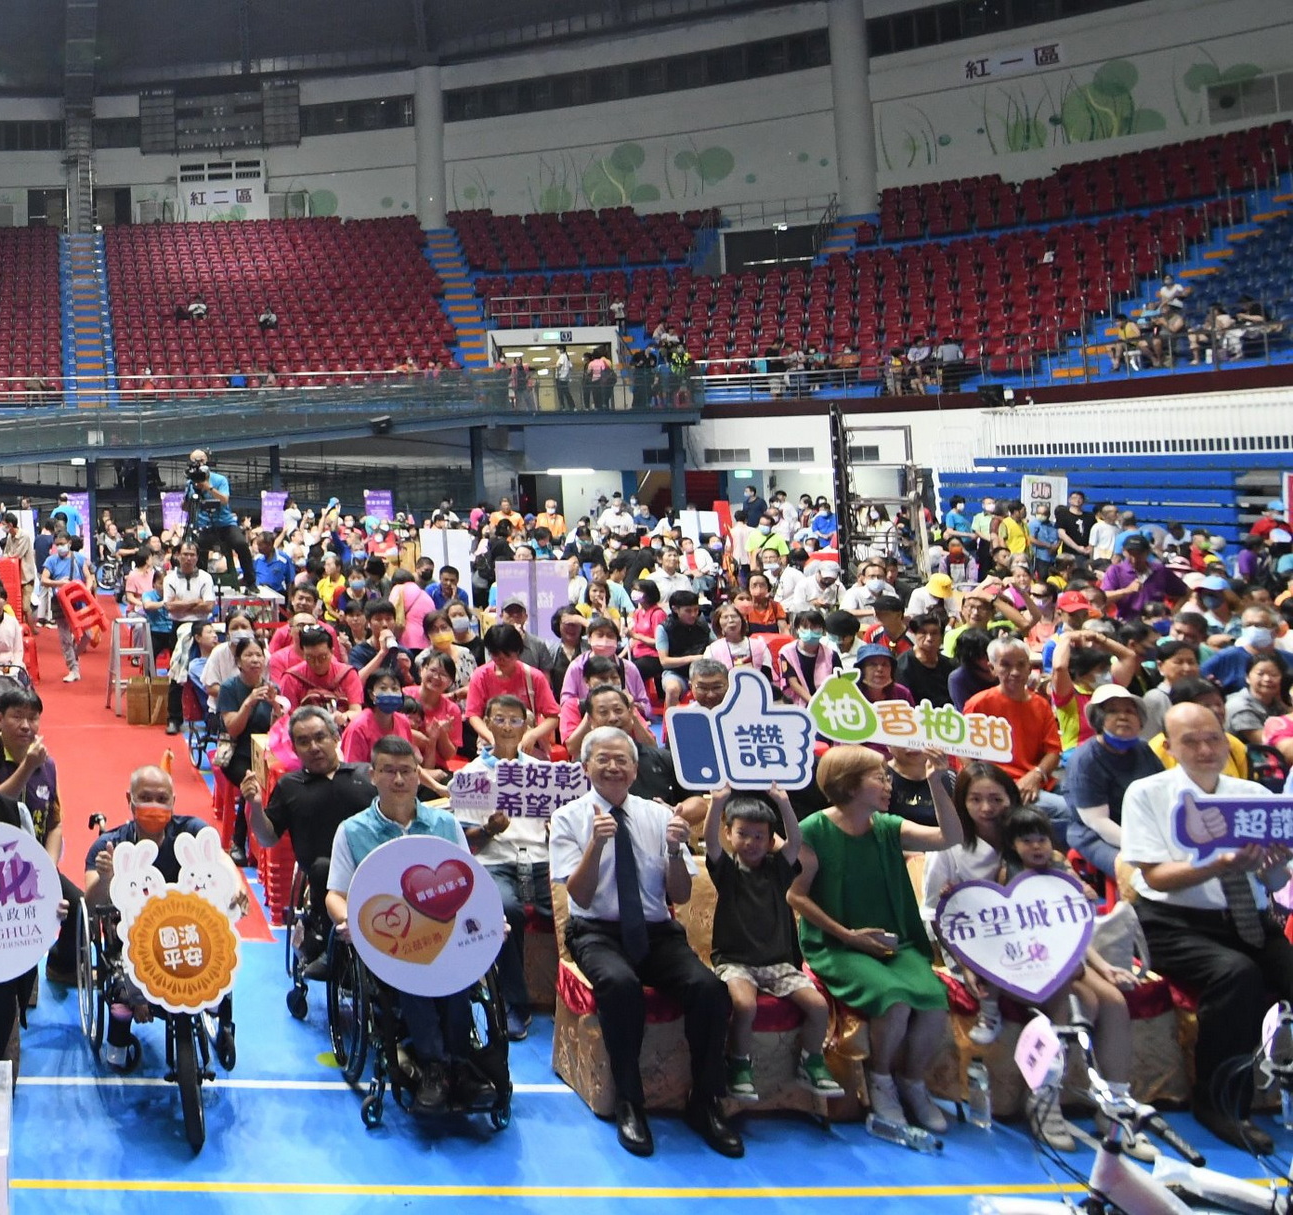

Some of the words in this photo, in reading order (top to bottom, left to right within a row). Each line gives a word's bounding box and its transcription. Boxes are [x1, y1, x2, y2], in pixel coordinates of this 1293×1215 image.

[965, 43, 1060, 79] 紅一區
[190, 187, 253, 206] 紅二區
[819, 692, 1011, 752] 柚香柚甜
[734, 724, 789, 769] 讚
[951, 746, 983, 757] Festival
[1233, 807, 1293, 840] 超讚
[941, 894, 1089, 941] 希望城市
[163, 945, 203, 971] 平安
